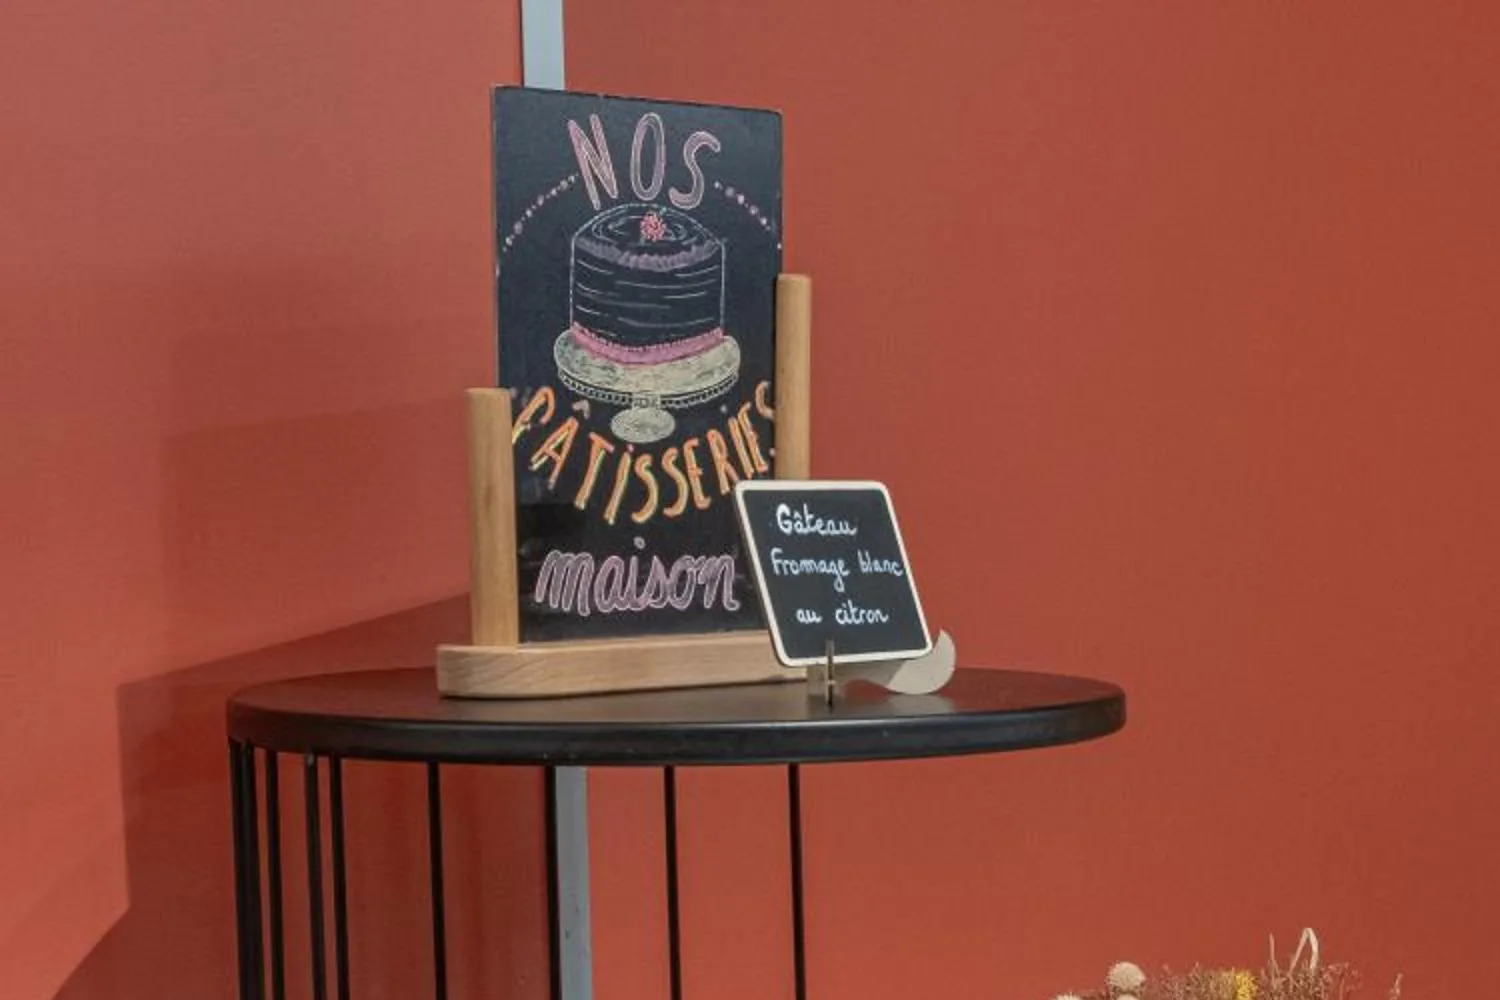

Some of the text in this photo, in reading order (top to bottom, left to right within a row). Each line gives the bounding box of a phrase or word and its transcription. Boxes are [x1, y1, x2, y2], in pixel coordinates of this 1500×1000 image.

[567, 112, 721, 209] NOS
[776, 503, 858, 536] Gâteau
[535, 537, 740, 615] maison
[857, 550, 904, 577] blanc
[796, 600, 889, 625] au citron
